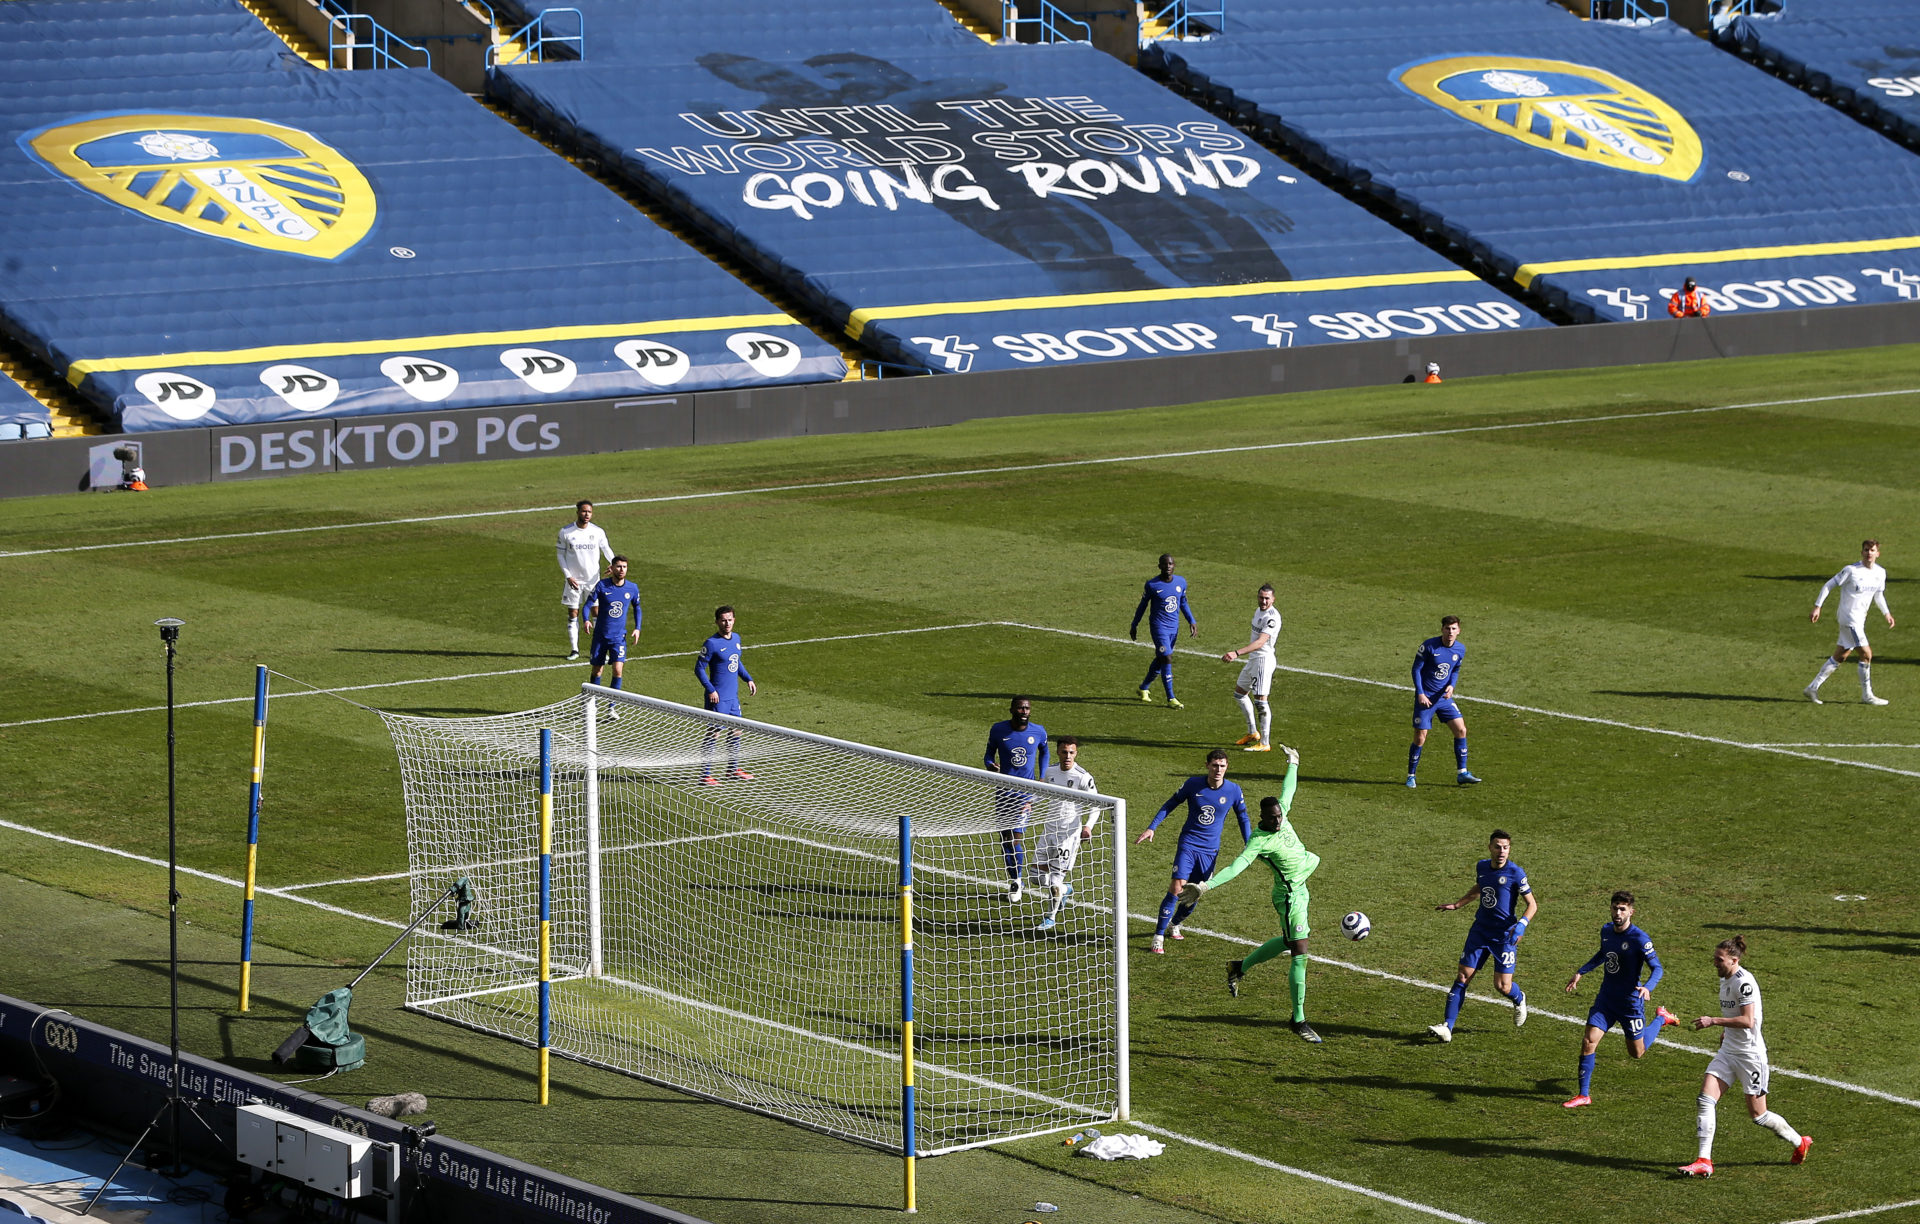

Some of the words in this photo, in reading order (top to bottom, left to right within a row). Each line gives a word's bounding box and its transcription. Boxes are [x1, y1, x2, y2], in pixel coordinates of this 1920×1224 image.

[678, 105, 951, 139] UNTIL
[936, 96, 1124, 129] THE
[635, 136, 967, 175] WORLD
[972, 122, 1246, 163] STOPS
[742, 161, 1000, 220] GOING
[1308, 301, 1521, 340] SBOTOP
[747, 340, 789, 360] JD
[992, 322, 1218, 363] SBOTOP
[521, 356, 565, 376] JD
[635, 348, 678, 368] JD
[281, 374, 327, 394] JD
[402, 364, 447, 384] JD
[157, 381, 203, 402] JD
[220, 420, 458, 474] DESKTOP
[477, 414, 561, 455] PCs
[618, 645, 626, 658] 5
[1501, 951, 1515, 965] 28
[1629, 1018, 1643, 1033] 10
[109, 1042, 134, 1070] The
[139, 1053, 173, 1087] Snag
[181, 1066, 208, 1094] List
[1751, 1071, 1760, 1085] 2
[438, 1152, 480, 1189] Snag
[485, 1167, 516, 1197] List
[522, 1179, 612, 1224] Eliminator
